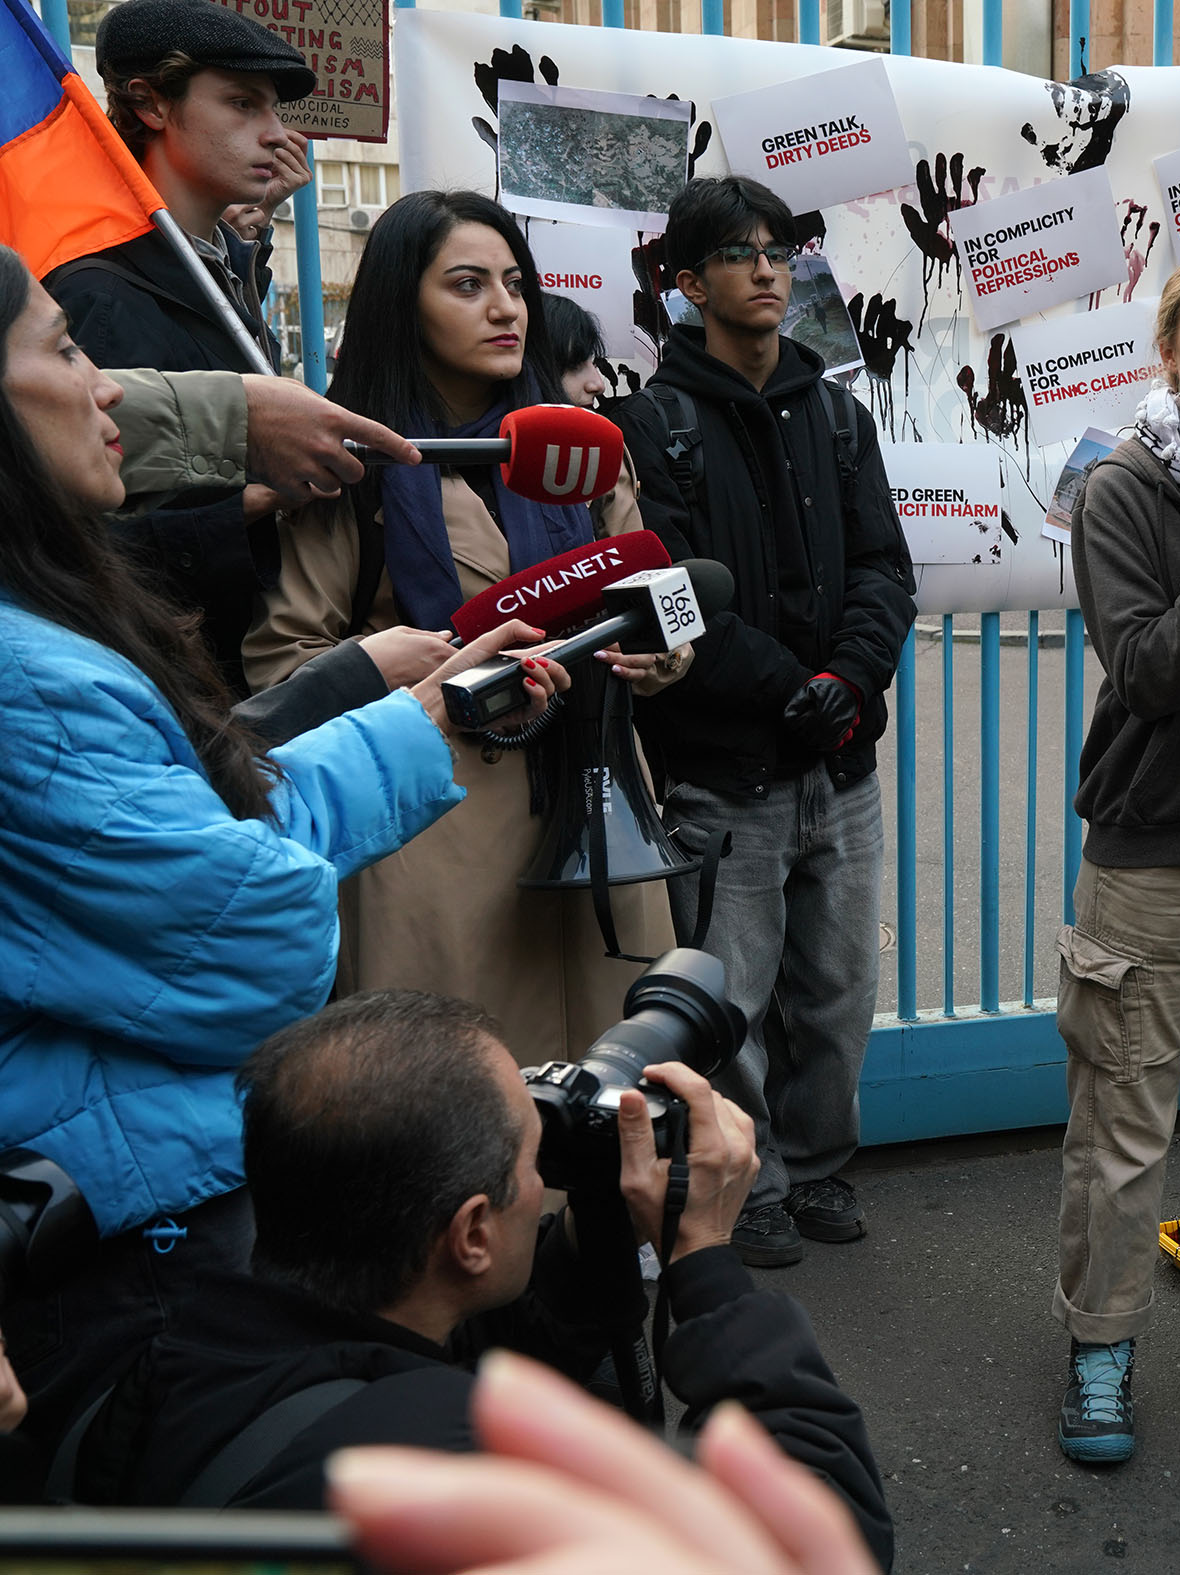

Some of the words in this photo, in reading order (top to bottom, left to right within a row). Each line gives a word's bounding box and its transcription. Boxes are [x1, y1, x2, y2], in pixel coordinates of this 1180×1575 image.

[234, 0, 314, 22] OUT
[304, 53, 365, 78] ISM
[312, 78, 380, 104] LISM
[275, 112, 351, 129] OMPANIES
[762, 126, 818, 153] GREEN
[818, 114, 865, 138] TALK,
[765, 143, 813, 170] DIRTY
[815, 128, 872, 156] DEEDS
[963, 236, 983, 253] IN
[983, 206, 1075, 247] COMPLICITY
[967, 247, 1001, 268] FOR
[971, 248, 1048, 282] POLITICAL
[536, 272, 603, 289] ASHING
[975, 252, 1081, 297] REPRESSIONS
[1025, 362, 1043, 378] IN
[1045, 340, 1136, 373] COMPLICITY
[1028, 373, 1062, 392] FOR
[1032, 381, 1089, 406] ETHNIC
[1090, 362, 1164, 393] CLEANSIN
[890, 488, 909, 502] ED
[911, 488, 969, 506] GREEN,
[898, 503, 928, 517] ICIT
[930, 504, 948, 517] IN
[950, 504, 999, 518] HARM
[495, 552, 607, 614] CIVILNET
[672, 583, 697, 627] 168
